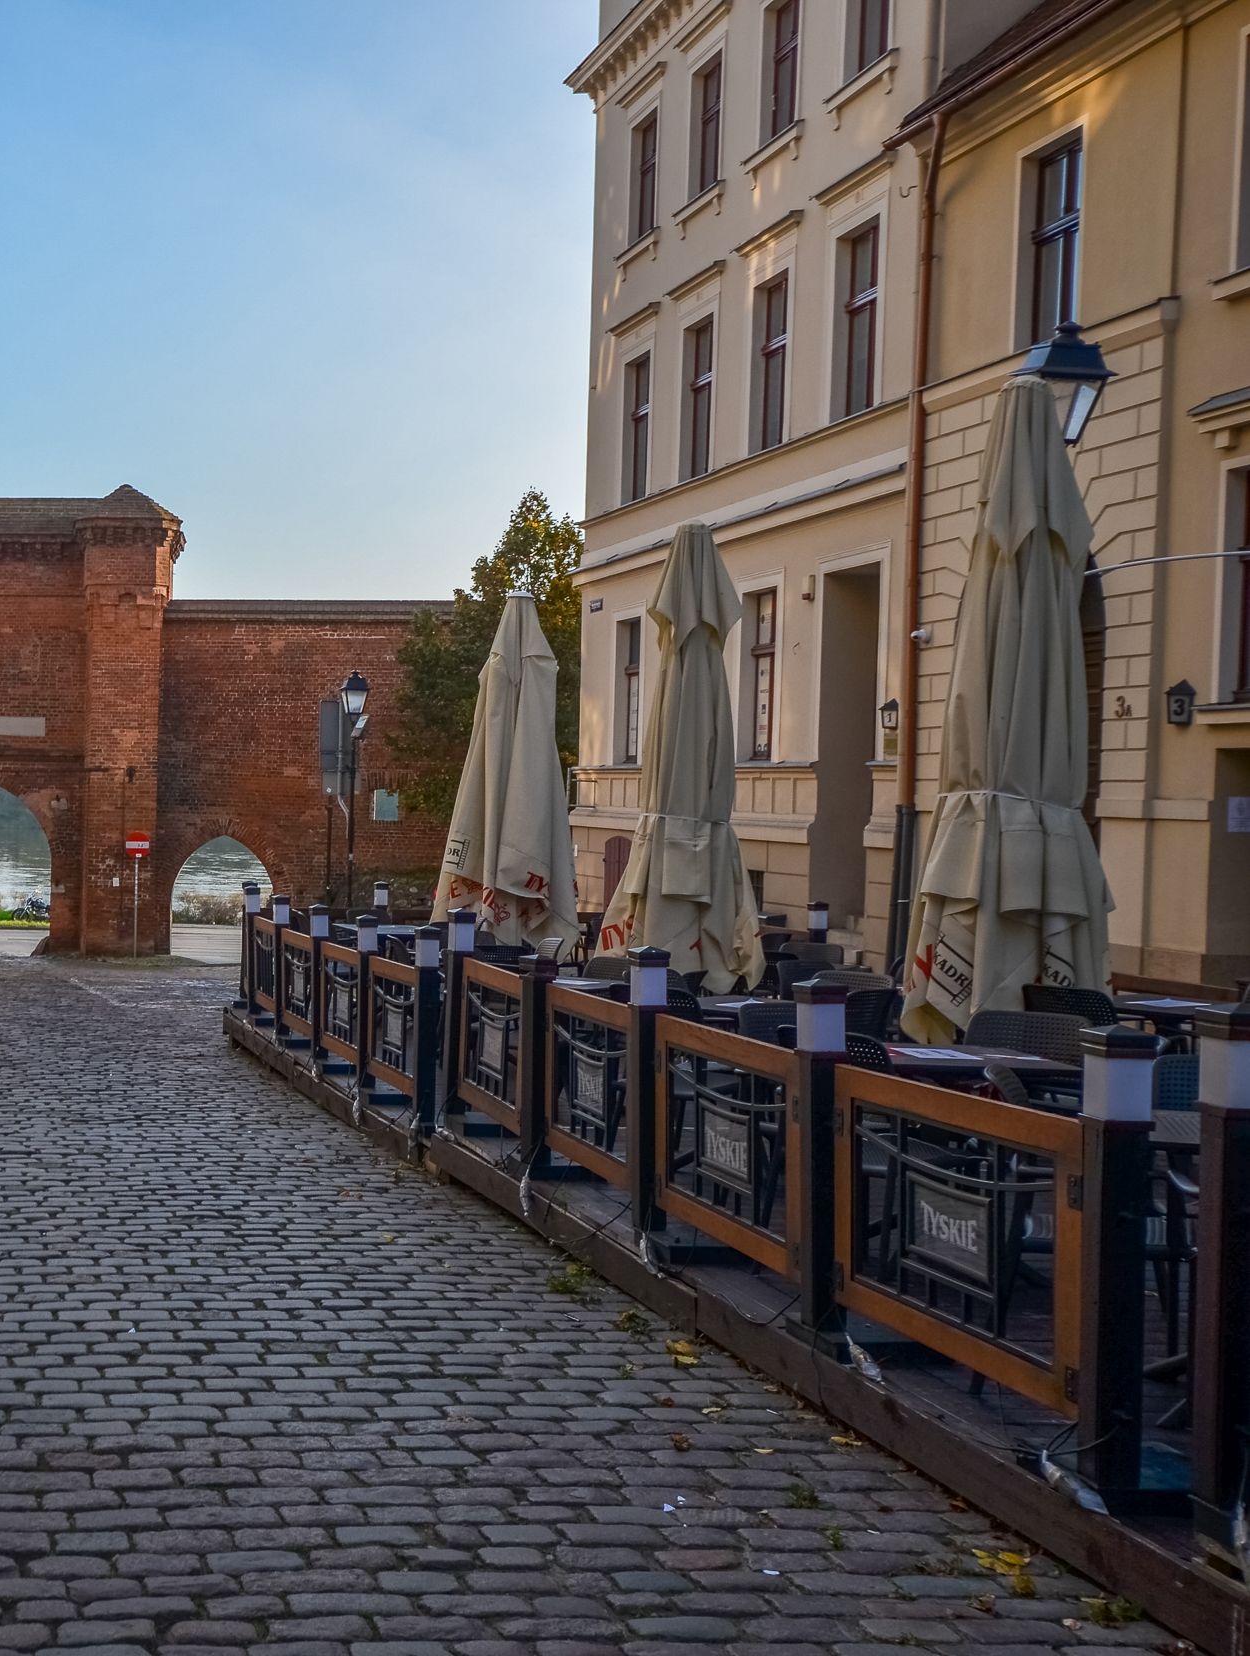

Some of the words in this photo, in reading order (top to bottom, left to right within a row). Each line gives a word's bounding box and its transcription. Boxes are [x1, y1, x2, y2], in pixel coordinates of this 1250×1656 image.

[886, 712, 892, 723] 1
[1173, 698, 1185, 716] 3
[933, 951, 969, 987] KADR
[1042, 962, 1076, 987] KAD
[704, 1125, 748, 1174] TYSKIE
[919, 1200, 978, 1254] TYSKIE
